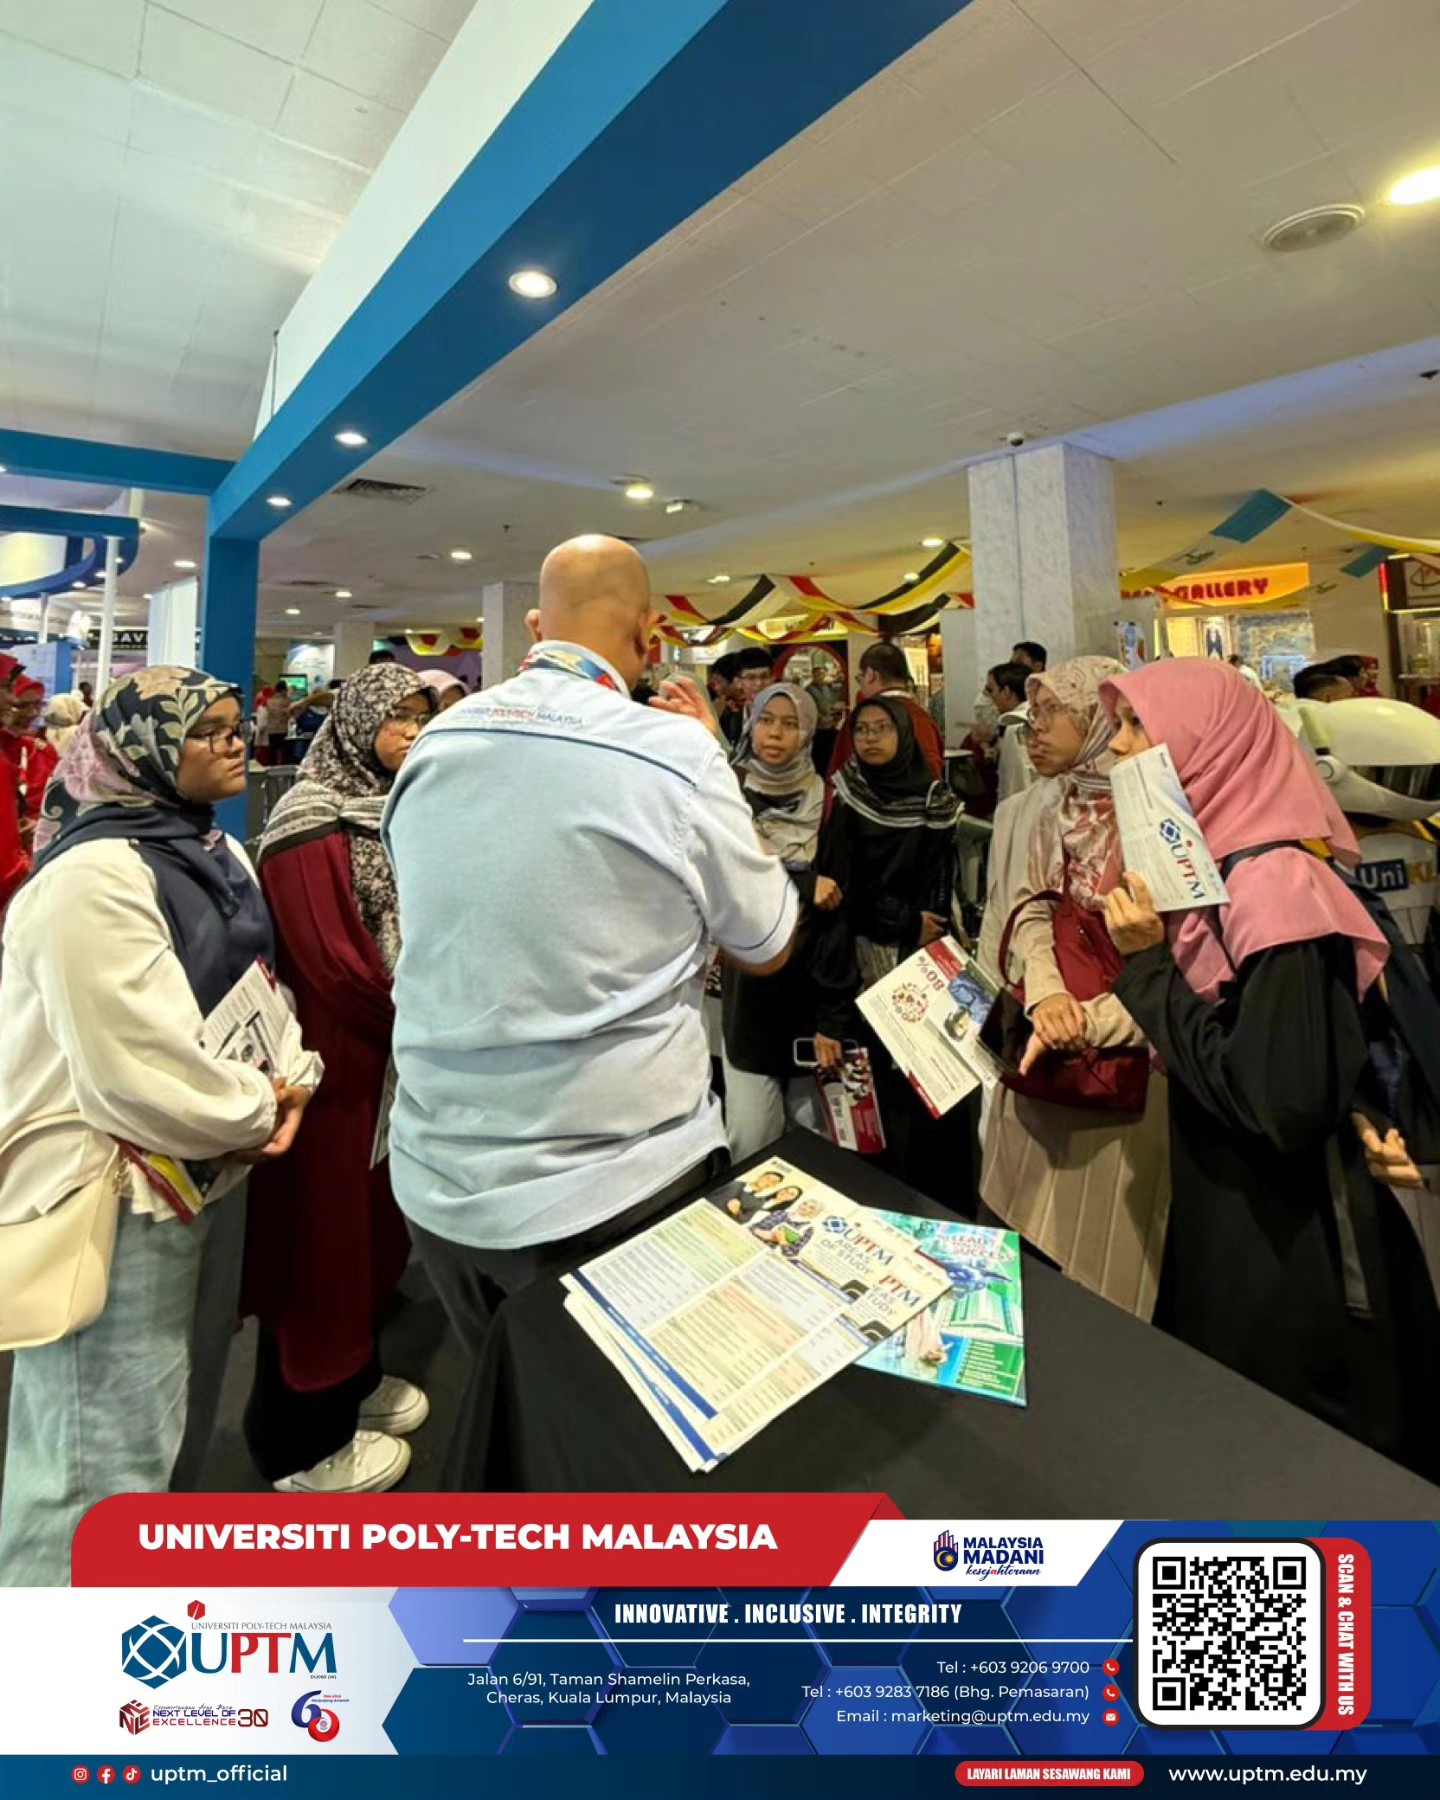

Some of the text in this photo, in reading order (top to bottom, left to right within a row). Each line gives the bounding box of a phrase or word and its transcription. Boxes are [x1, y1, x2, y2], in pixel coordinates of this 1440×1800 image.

[1169, 843, 1206, 899] UPTM
[916, 954, 946, 992] 80%
[878, 1273, 920, 1308] PTM
